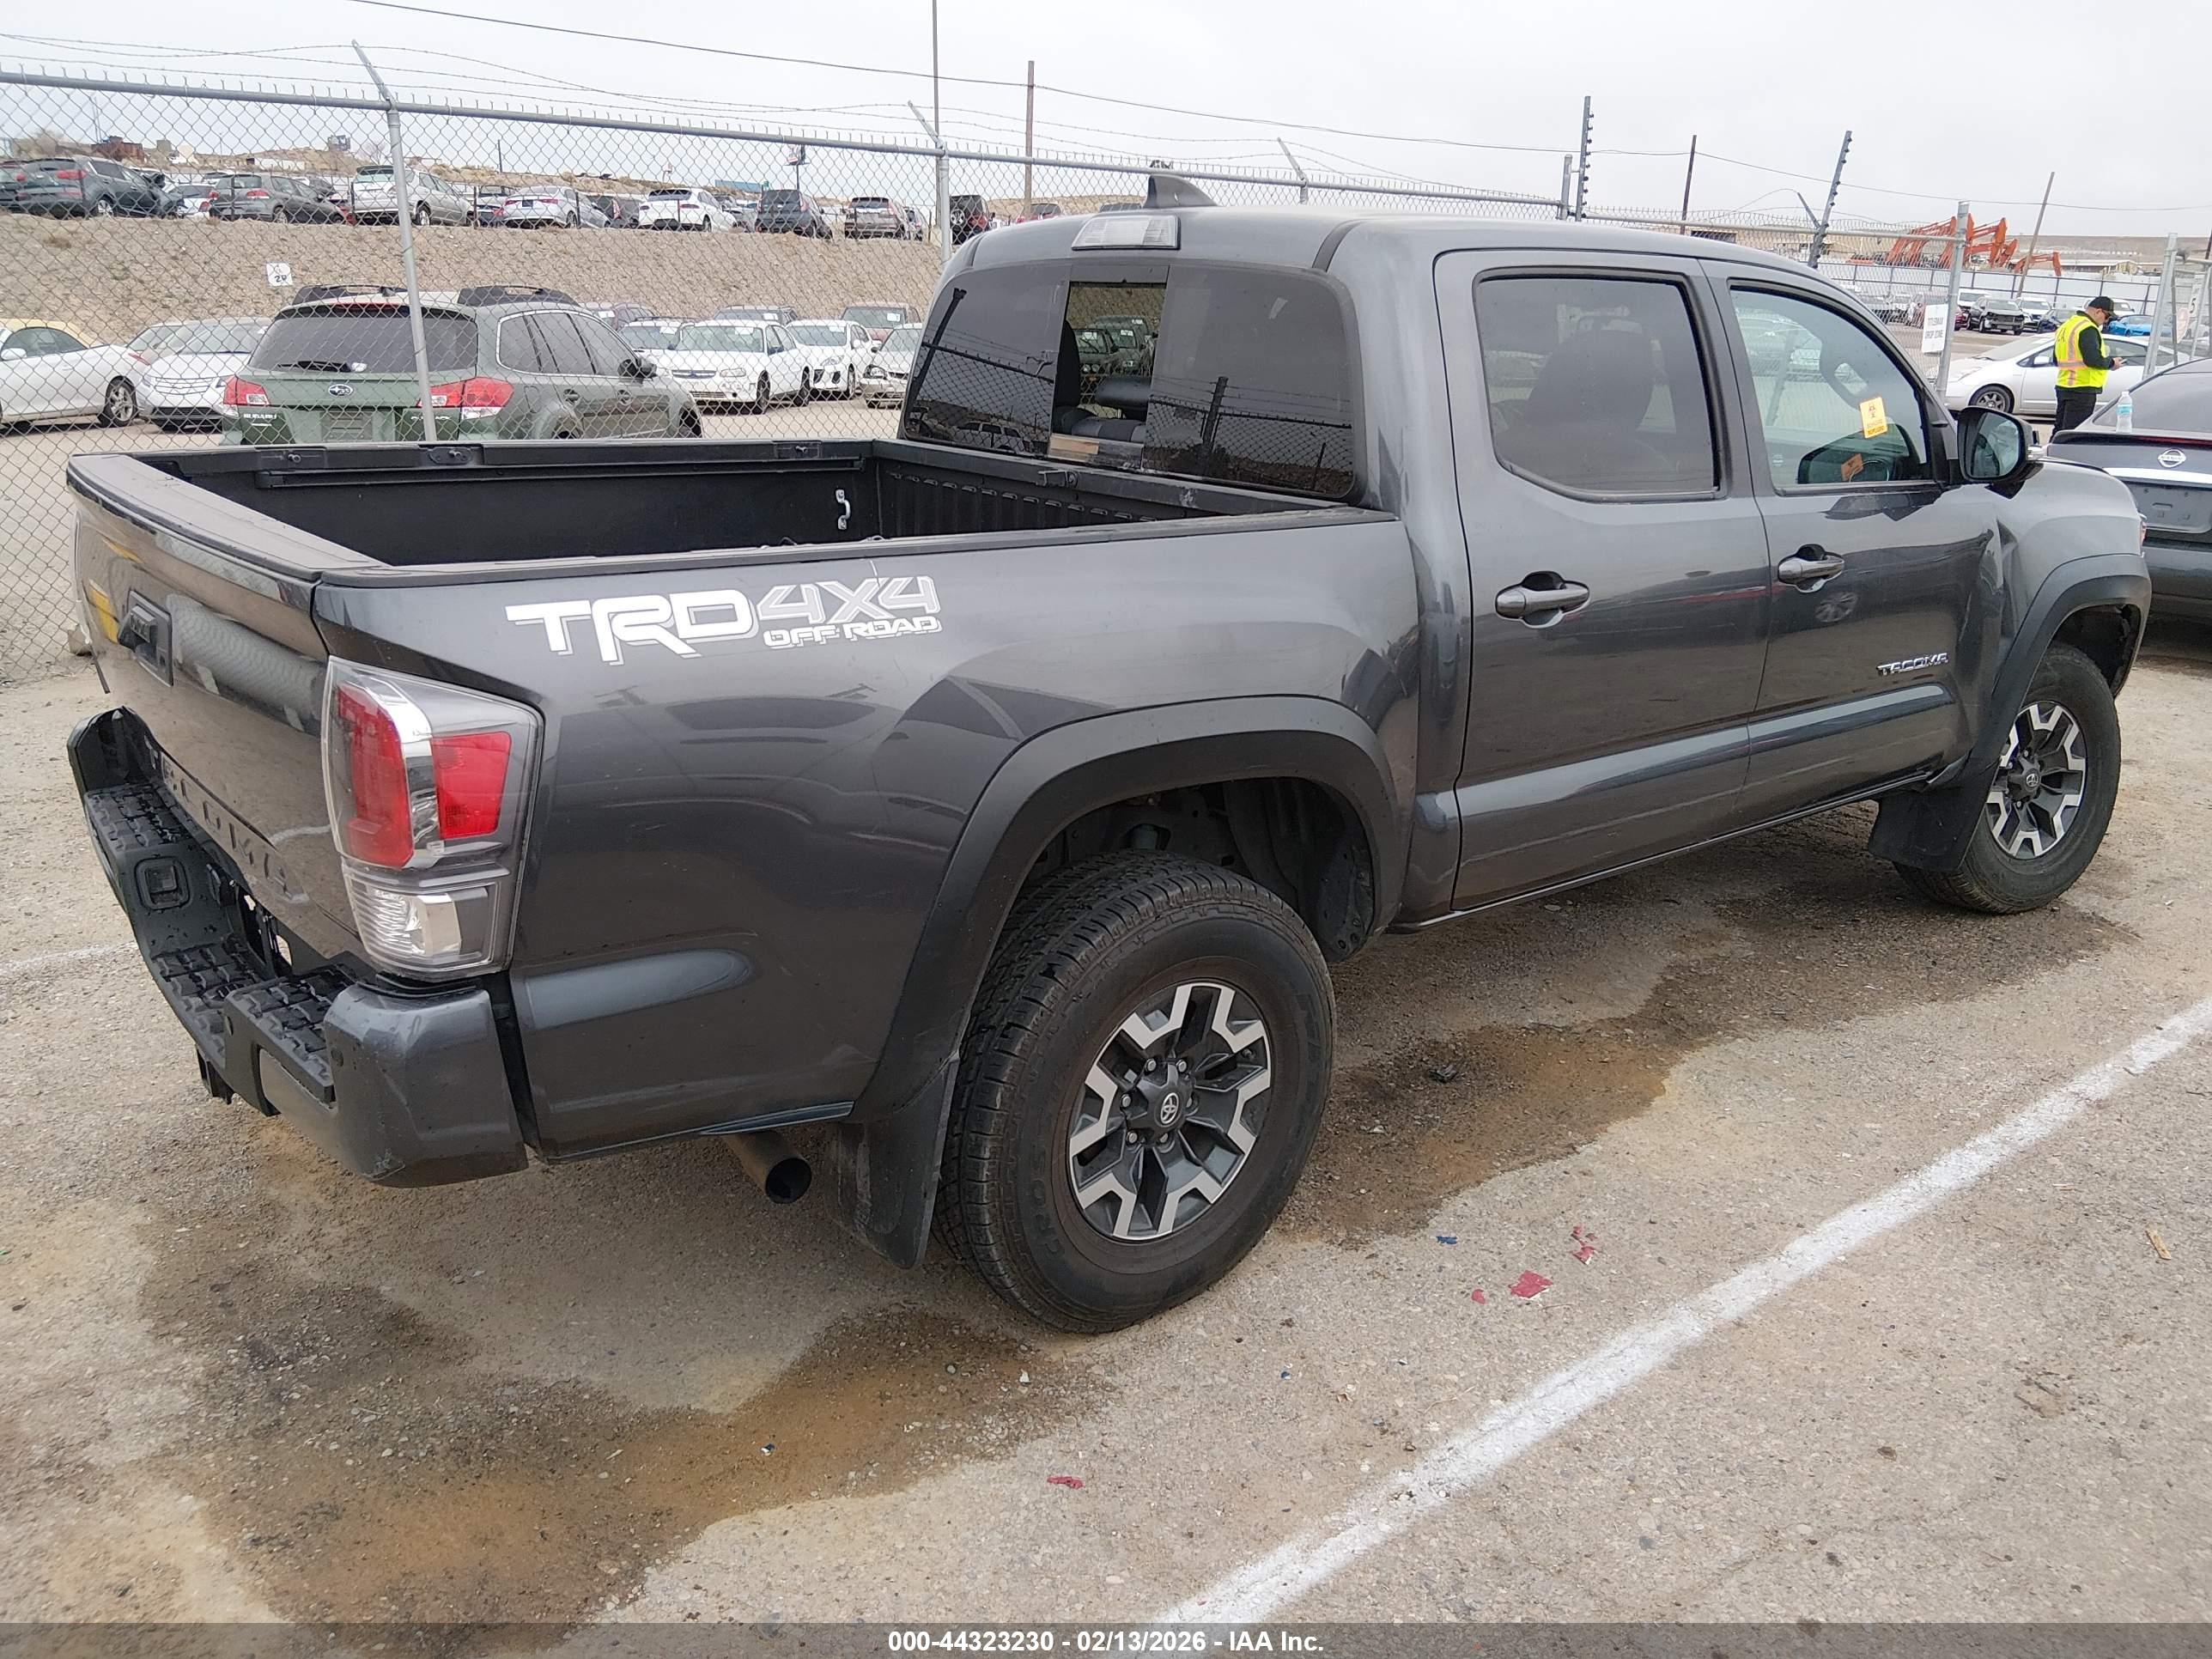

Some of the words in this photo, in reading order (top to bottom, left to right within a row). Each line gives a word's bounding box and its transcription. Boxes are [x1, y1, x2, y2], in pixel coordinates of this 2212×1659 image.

[2189, 296, 2197, 314] 5
[505, 589, 759, 666] TRD
[756, 575, 941, 624] 4X4
[1875, 653, 1948, 676] TACOMA
